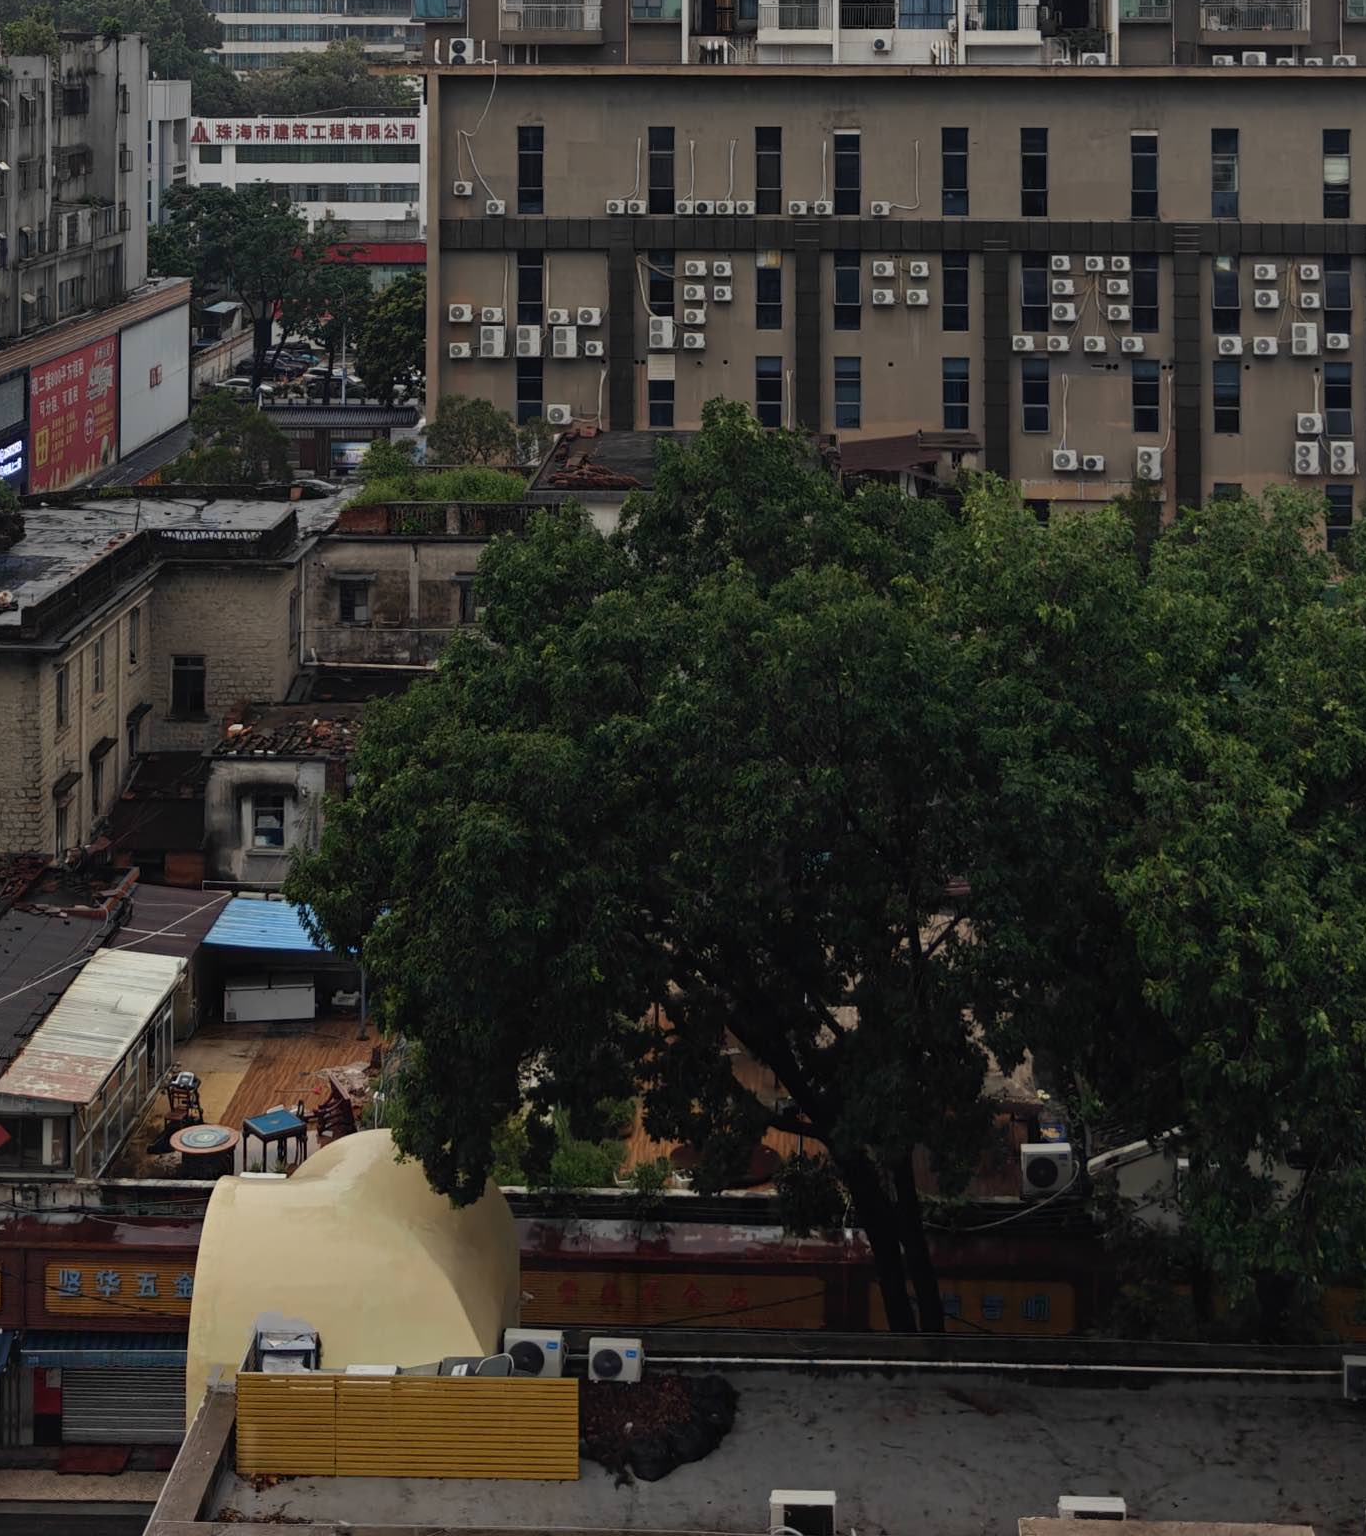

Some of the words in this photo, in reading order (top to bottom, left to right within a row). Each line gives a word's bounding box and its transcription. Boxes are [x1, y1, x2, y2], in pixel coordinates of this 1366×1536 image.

[215, 123, 417, 141] 珠海市建筑工程有限公司
[58, 1269, 193, 1298] 坚华五金
